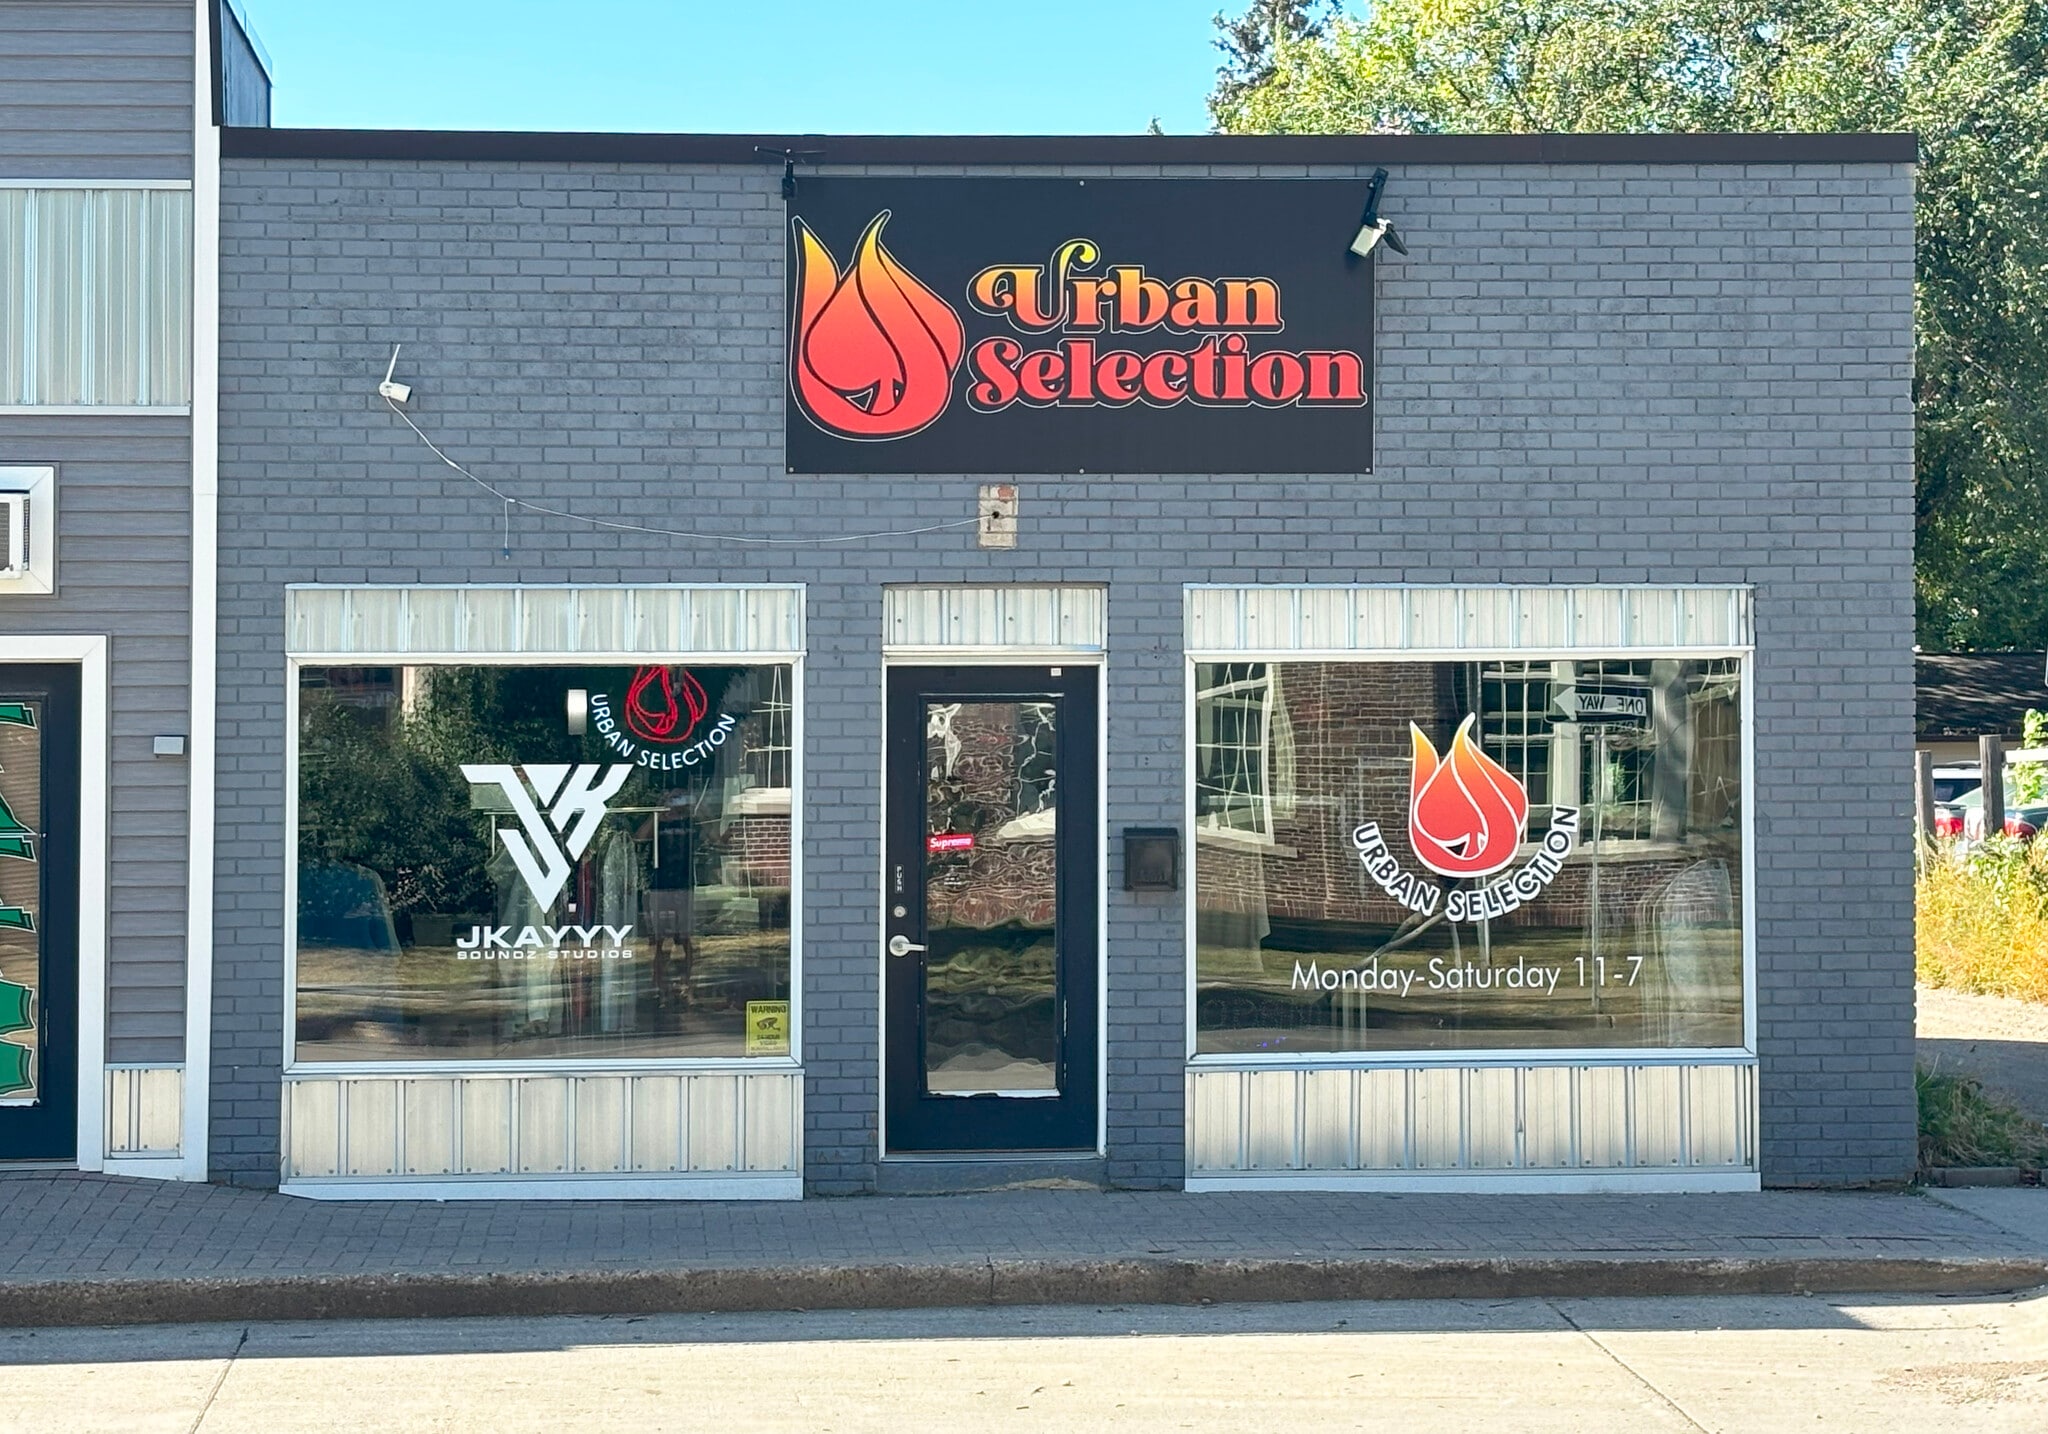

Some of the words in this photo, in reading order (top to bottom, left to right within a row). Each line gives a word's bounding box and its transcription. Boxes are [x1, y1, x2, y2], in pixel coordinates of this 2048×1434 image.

[970, 240, 1284, 331] Urban
[970, 334, 1365, 408] Selection
[590, 693, 636, 758] URBAN
[636, 712, 737, 771] SELECTION
[1354, 823, 1440, 915] URBAN
[1446, 805, 1579, 920] SELECTION
[456, 925, 634, 950] JKAYYY
[456, 950, 537, 961] SOUNDZ
[548, 949, 633, 960] STUDIOS
[1291, 956, 1562, 998] Monday-Saturday
[1574, 955, 1645, 988] 11-7
